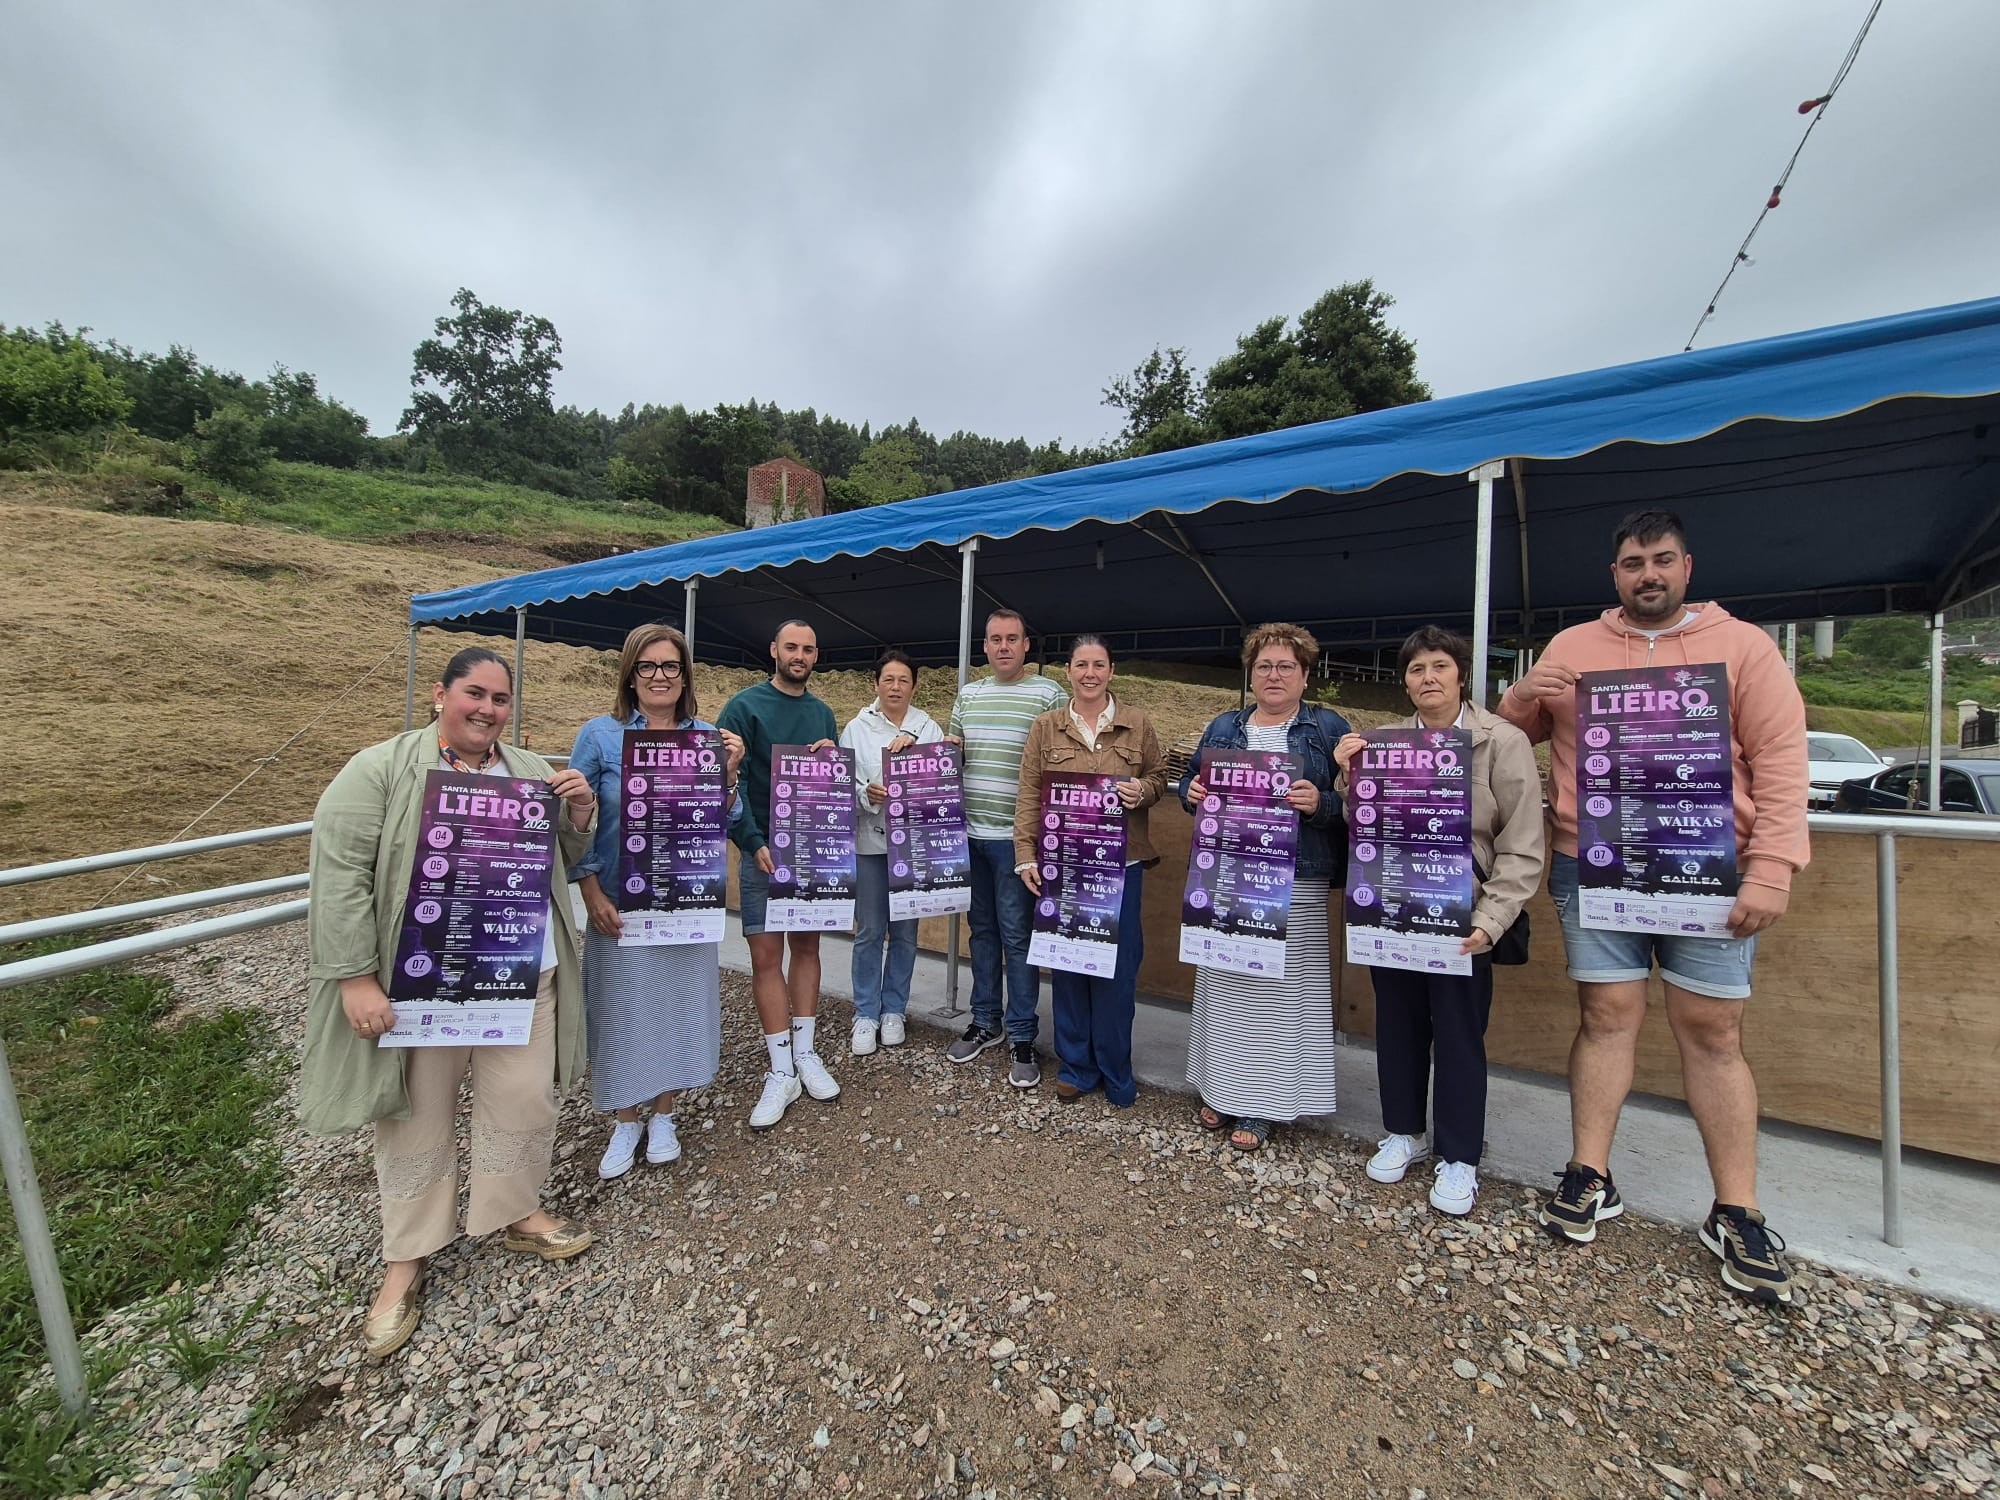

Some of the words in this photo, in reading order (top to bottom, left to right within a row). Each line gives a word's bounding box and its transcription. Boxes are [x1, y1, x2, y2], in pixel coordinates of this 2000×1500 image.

[1591, 684, 1620, 693] SANTA
[1621, 683, 1652, 691] ISABEL
[1591, 688, 1709, 715] LIEIRO
[1685, 705, 1718, 717] 2025
[1591, 731, 1603, 740] 04
[633, 749, 716, 767] LIEIRO
[1362, 750, 1458, 769] LIEIRO
[1592, 758, 1604, 768] 05
[700, 764, 720, 773] 2025
[780, 760, 847, 777] LIEIRO
[890, 757, 953, 775] LIEIRO
[1438, 766, 1464, 776] 2025
[1210, 768, 1290, 789] LIEIRO
[441, 785, 468, 794] SANTA
[470, 788, 498, 796] ISABEL
[1361, 784, 1371, 792] 04
[1655, 782, 1722, 790] PANORAMA
[1272, 787, 1291, 797] 202
[1050, 789, 1119, 808] LIEIRO
[1208, 799, 1216, 807] 04
[438, 793, 545, 820] LIEIRO
[1593, 800, 1605, 809] 06
[1104, 807, 1123, 815] 2025
[1361, 809, 1371, 817] 05
[1411, 807, 1436, 815] RITMO
[523, 819, 550, 830] 2025
[1205, 821, 1214, 829] 05
[1657, 816, 1723, 827] WAIKAS
[435, 830, 447, 841] 04
[1411, 833, 1463, 841] PANORAMA
[632, 838, 640, 846] 06
[930, 839, 963, 847] WAIKAS
[678, 850, 720, 858] WAIKAS
[816, 847, 850, 855] WAIKAS
[1245, 846, 1289, 856] PANORAMA
[1361, 847, 1371, 855] 06
[1594, 850, 1606, 859] 07
[1202, 855, 1210, 863] 06
[430, 861, 442, 871] 05
[490, 861, 517, 869] RITMO
[517, 862, 546, 871] JOVEN
[1412, 863, 1463, 876] WAIKAS
[631, 880, 640, 888] 07
[1243, 873, 1286, 886] WAIKAS
[1661, 875, 1722, 886] GALILEA
[486, 889, 541, 898] PANORAMA
[1083, 883, 1118, 894] WAIKAS
[1194, 895, 1203, 903] 07
[1359, 891, 1368, 899] 07
[422, 906, 435, 915] 06
[1237, 919, 1277, 931] GALILEA
[1411, 916, 1459, 927] GALILEA
[483, 923, 537, 935] WAIKAS
[1078, 925, 1111, 936] GALILEA
[412, 960, 424, 970] 07
[474, 982, 526, 990] GALILEA
